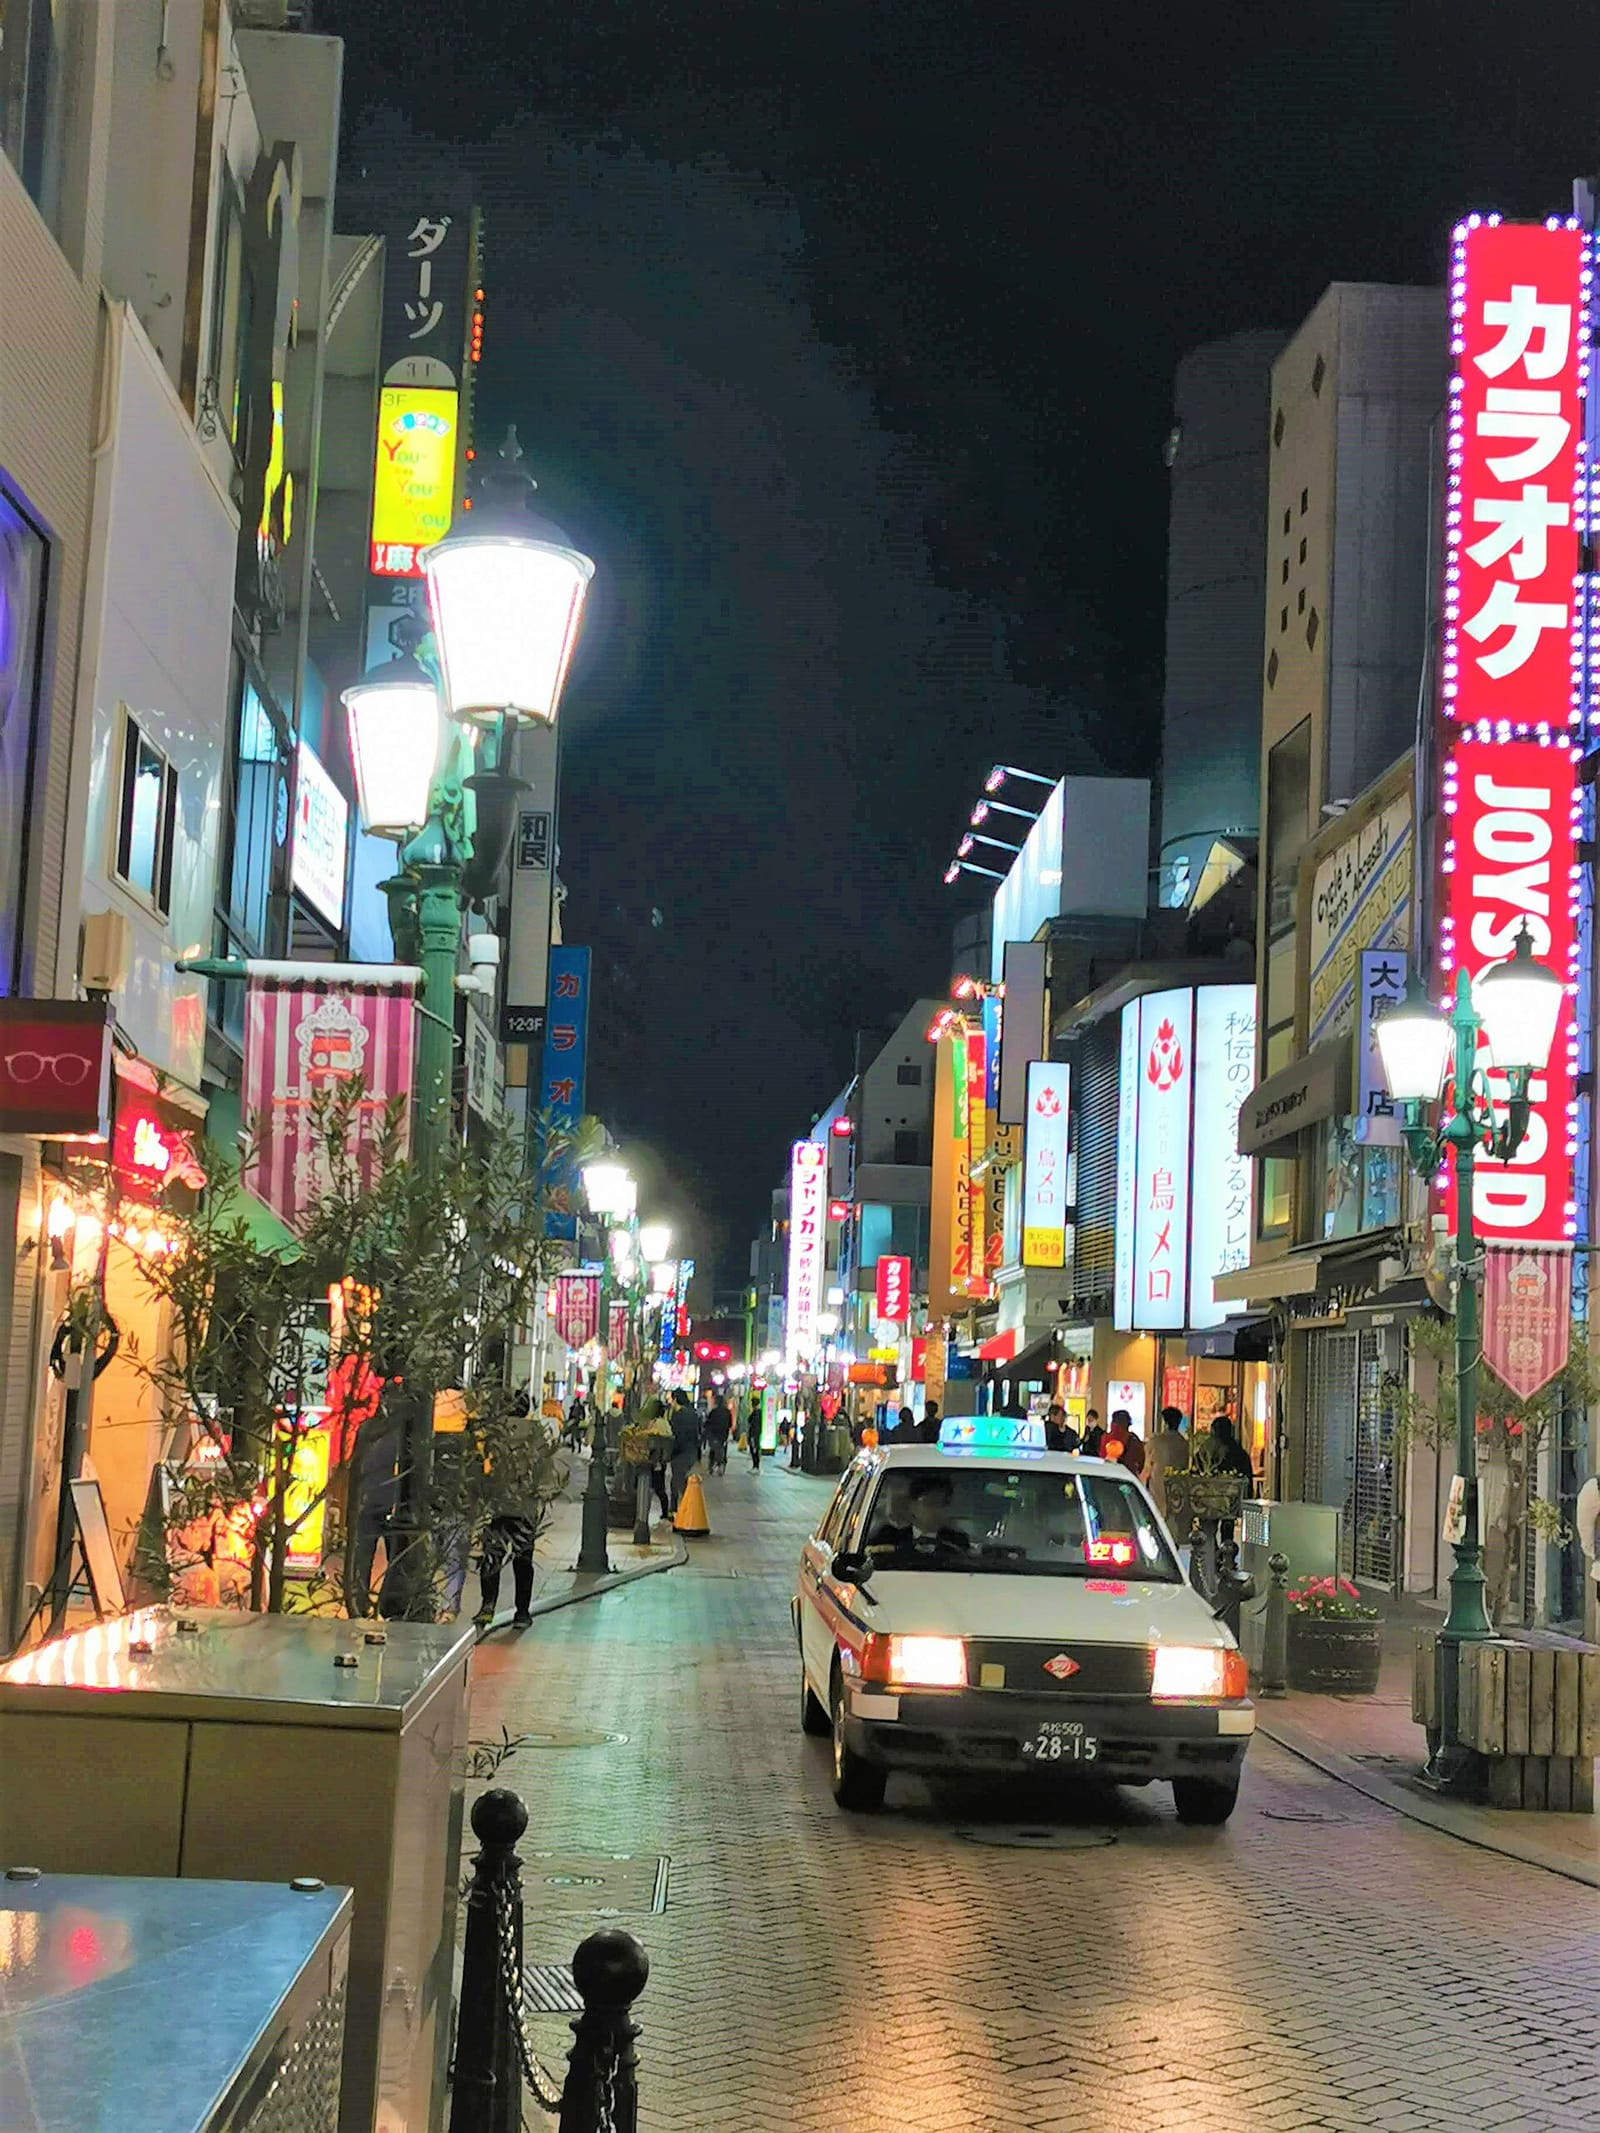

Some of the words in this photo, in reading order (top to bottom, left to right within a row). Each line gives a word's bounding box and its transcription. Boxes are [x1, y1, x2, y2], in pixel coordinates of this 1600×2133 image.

[404, 216, 452, 339] ダーツ
[383, 393, 408, 407] 3F
[1463, 285, 1572, 680] カラオケ
[521, 816, 547, 867] 和民
[1366, 960, 1400, 1117] 大店
[1471, 775, 1553, 1228] JOYSND
[1149, 1167, 1177, 1302] 鳥メロ
[986, 1423, 1033, 1442] TAXI
[1035, 1735, 1097, 1760] 28-15
